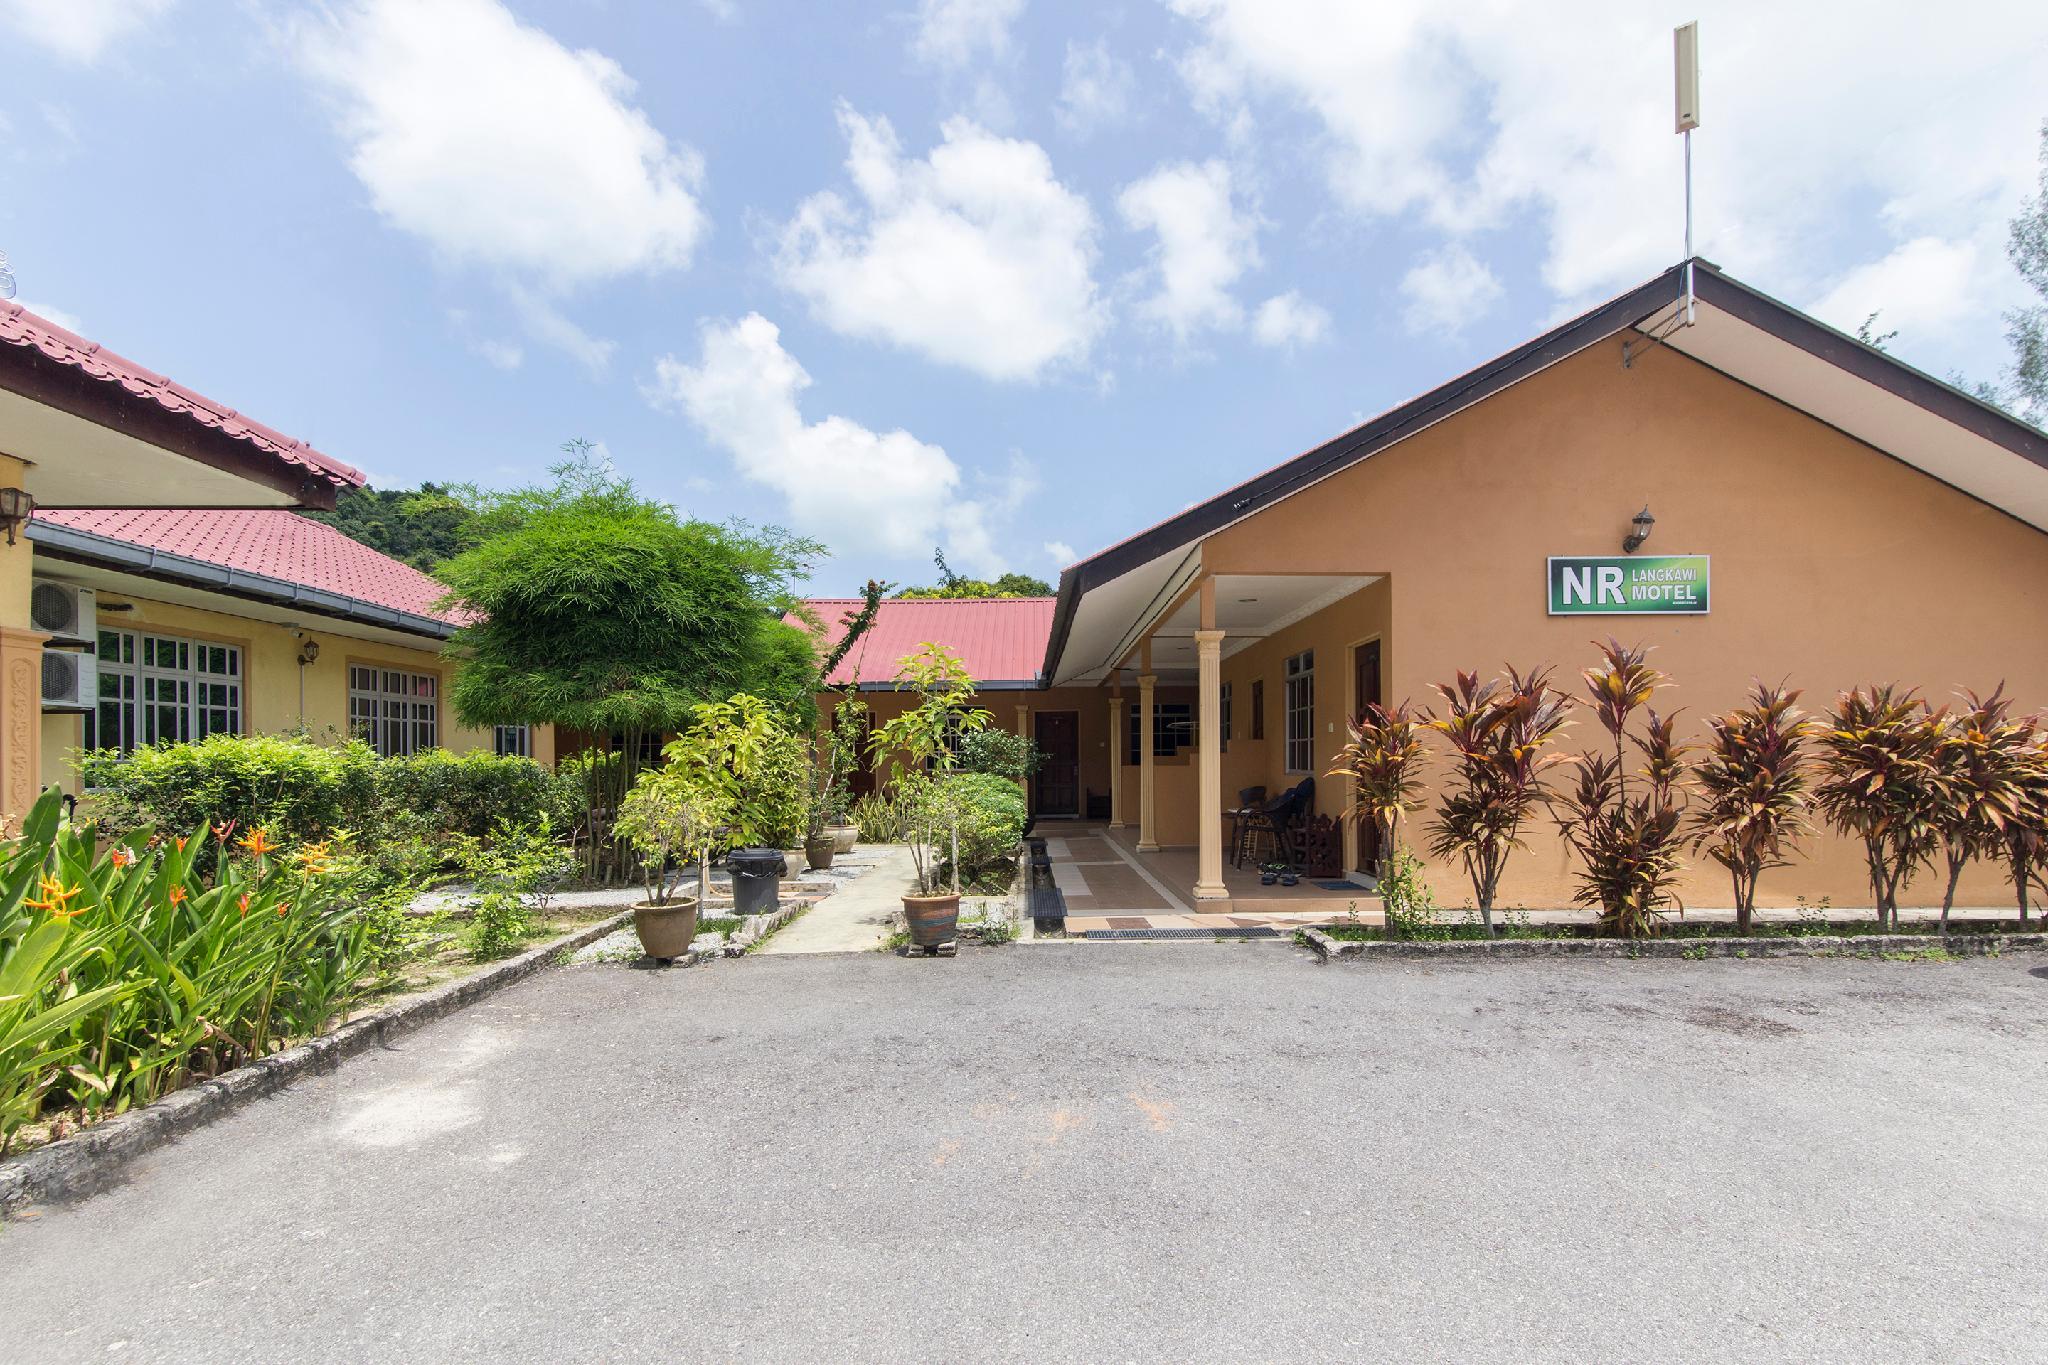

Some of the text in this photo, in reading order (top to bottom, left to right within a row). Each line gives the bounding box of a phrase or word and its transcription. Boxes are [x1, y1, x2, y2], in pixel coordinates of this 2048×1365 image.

[1632, 569, 1697, 582] LANGKAWI
[1562, 566, 1626, 605] NR
[1632, 584, 1697, 600] MOTEL
